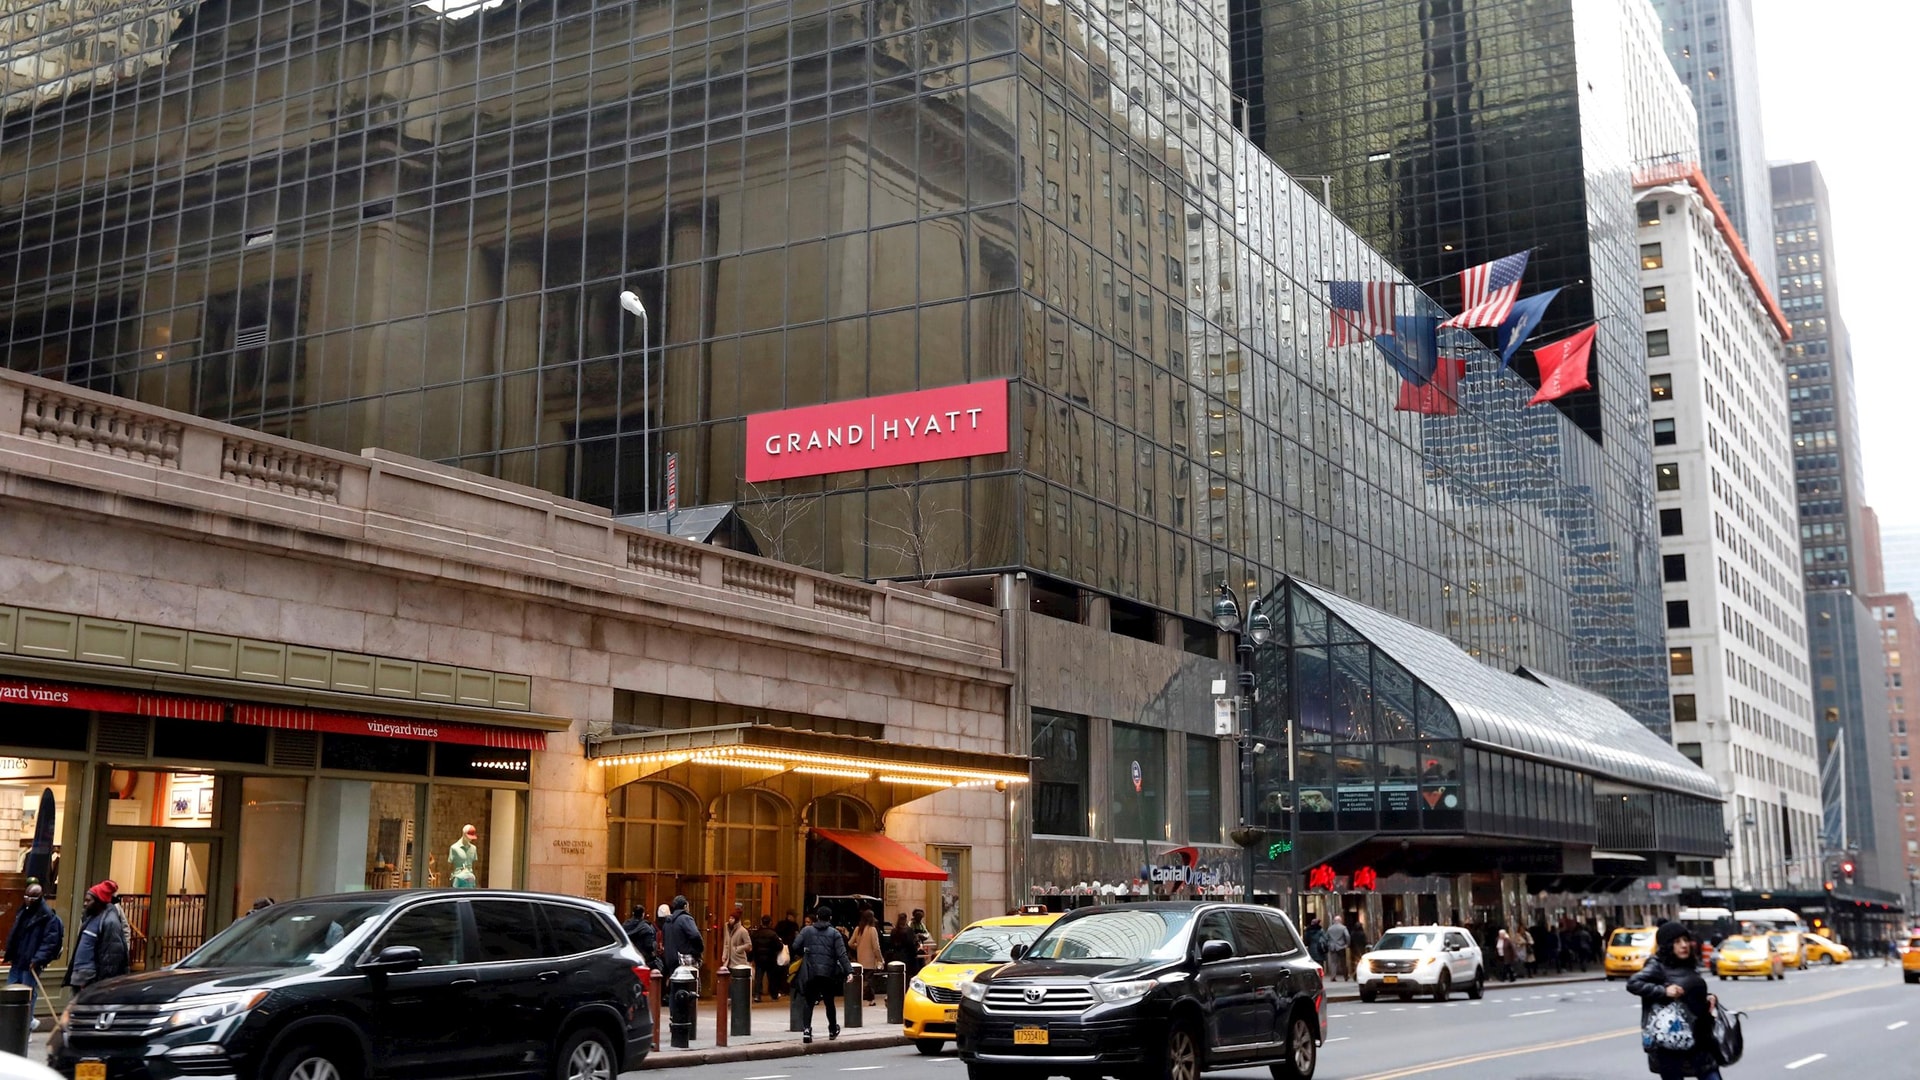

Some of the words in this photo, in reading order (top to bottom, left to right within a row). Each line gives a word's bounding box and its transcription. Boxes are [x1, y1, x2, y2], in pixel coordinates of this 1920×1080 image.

[765, 425, 864, 455] GRAND
[883, 408, 983, 441] HYATT
[31, 687, 69, 702] vines
[367, 720, 411, 737] vineyard
[412, 724, 438, 738] vines
